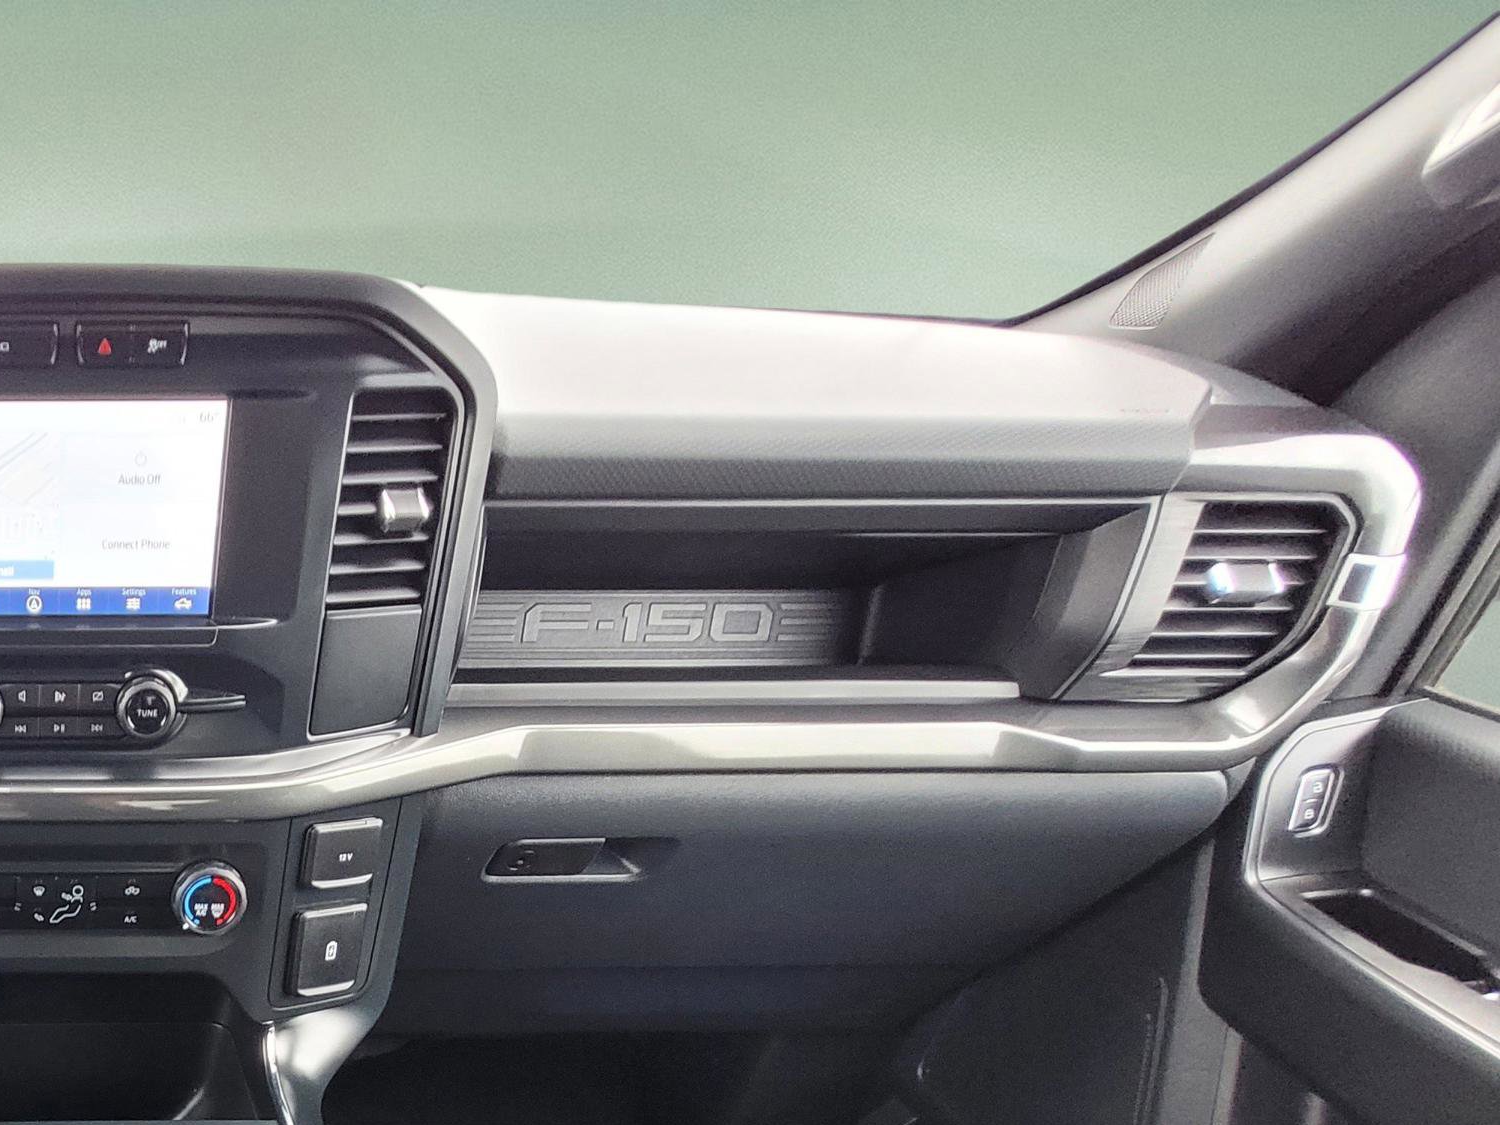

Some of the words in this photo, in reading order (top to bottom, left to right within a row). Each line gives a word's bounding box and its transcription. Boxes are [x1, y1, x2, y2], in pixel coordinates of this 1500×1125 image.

[118, 473, 145, 486] Audio
[147, 473, 161, 486] Off
[102, 539, 139, 550] Connect
[141, 539, 171, 550] Phone
[122, 588, 146, 597] Settings
[171, 588, 197, 596] Features
[520, 601, 775, 644] F-150
[136, 708, 158, 718] TUNE
[124, 915, 137, 924] A/C
